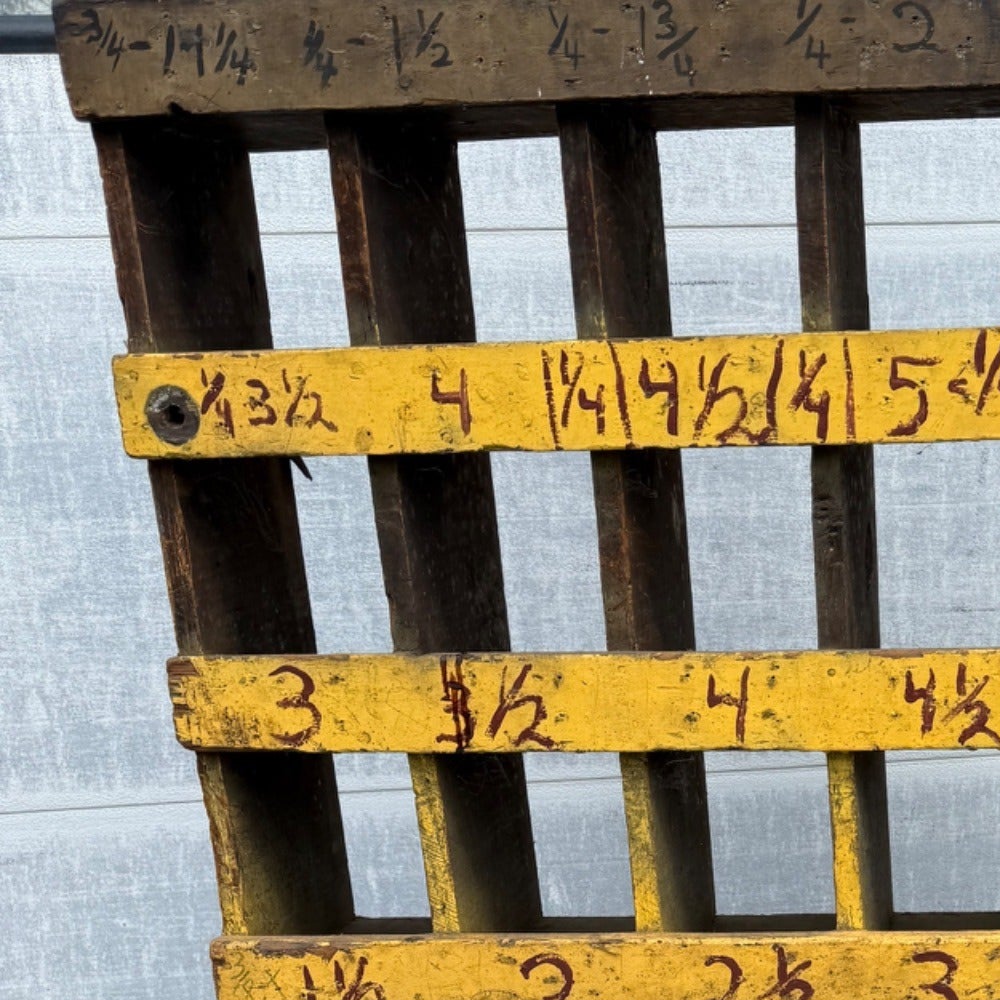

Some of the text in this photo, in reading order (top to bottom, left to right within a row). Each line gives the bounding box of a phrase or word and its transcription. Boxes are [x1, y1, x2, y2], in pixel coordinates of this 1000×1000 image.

[431, 367, 471, 437] 4
[886, 356, 942, 437] 5
[268, 665, 321, 746] 3
[707, 666, 750, 744] 4
